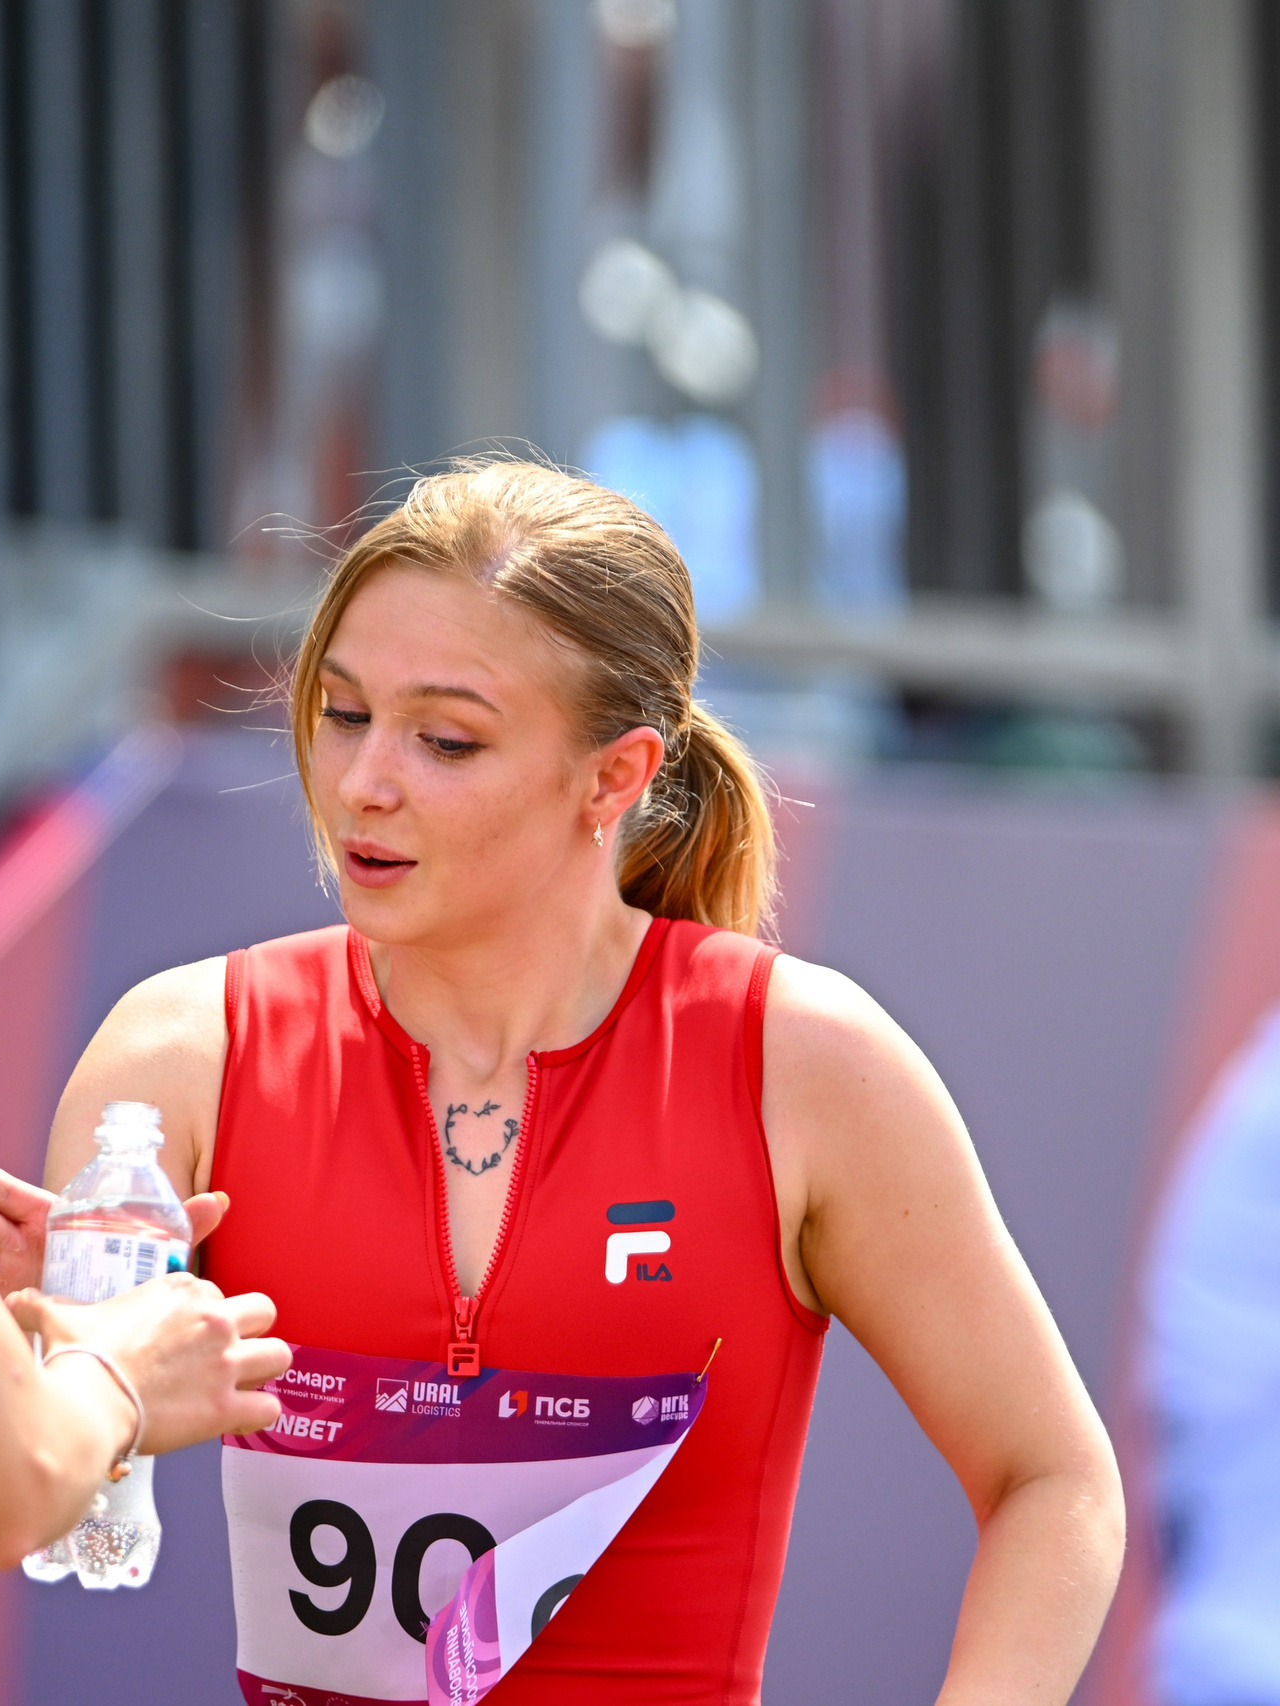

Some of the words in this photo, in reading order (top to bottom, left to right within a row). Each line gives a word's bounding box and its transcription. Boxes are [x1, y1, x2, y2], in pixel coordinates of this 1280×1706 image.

[282, 1388, 309, 1398] УМНОЙ
[310, 1392, 345, 1404] ТЕХНИКИ
[413, 1381, 461, 1404] URAL
[412, 1404, 461, 1418] LOGISTICS
[535, 1396, 590, 1418] ПСБ
[661, 1394, 689, 1414] НГК
[660, 1411, 689, 1422] ресурс
[288, 1499, 498, 1645] 90
